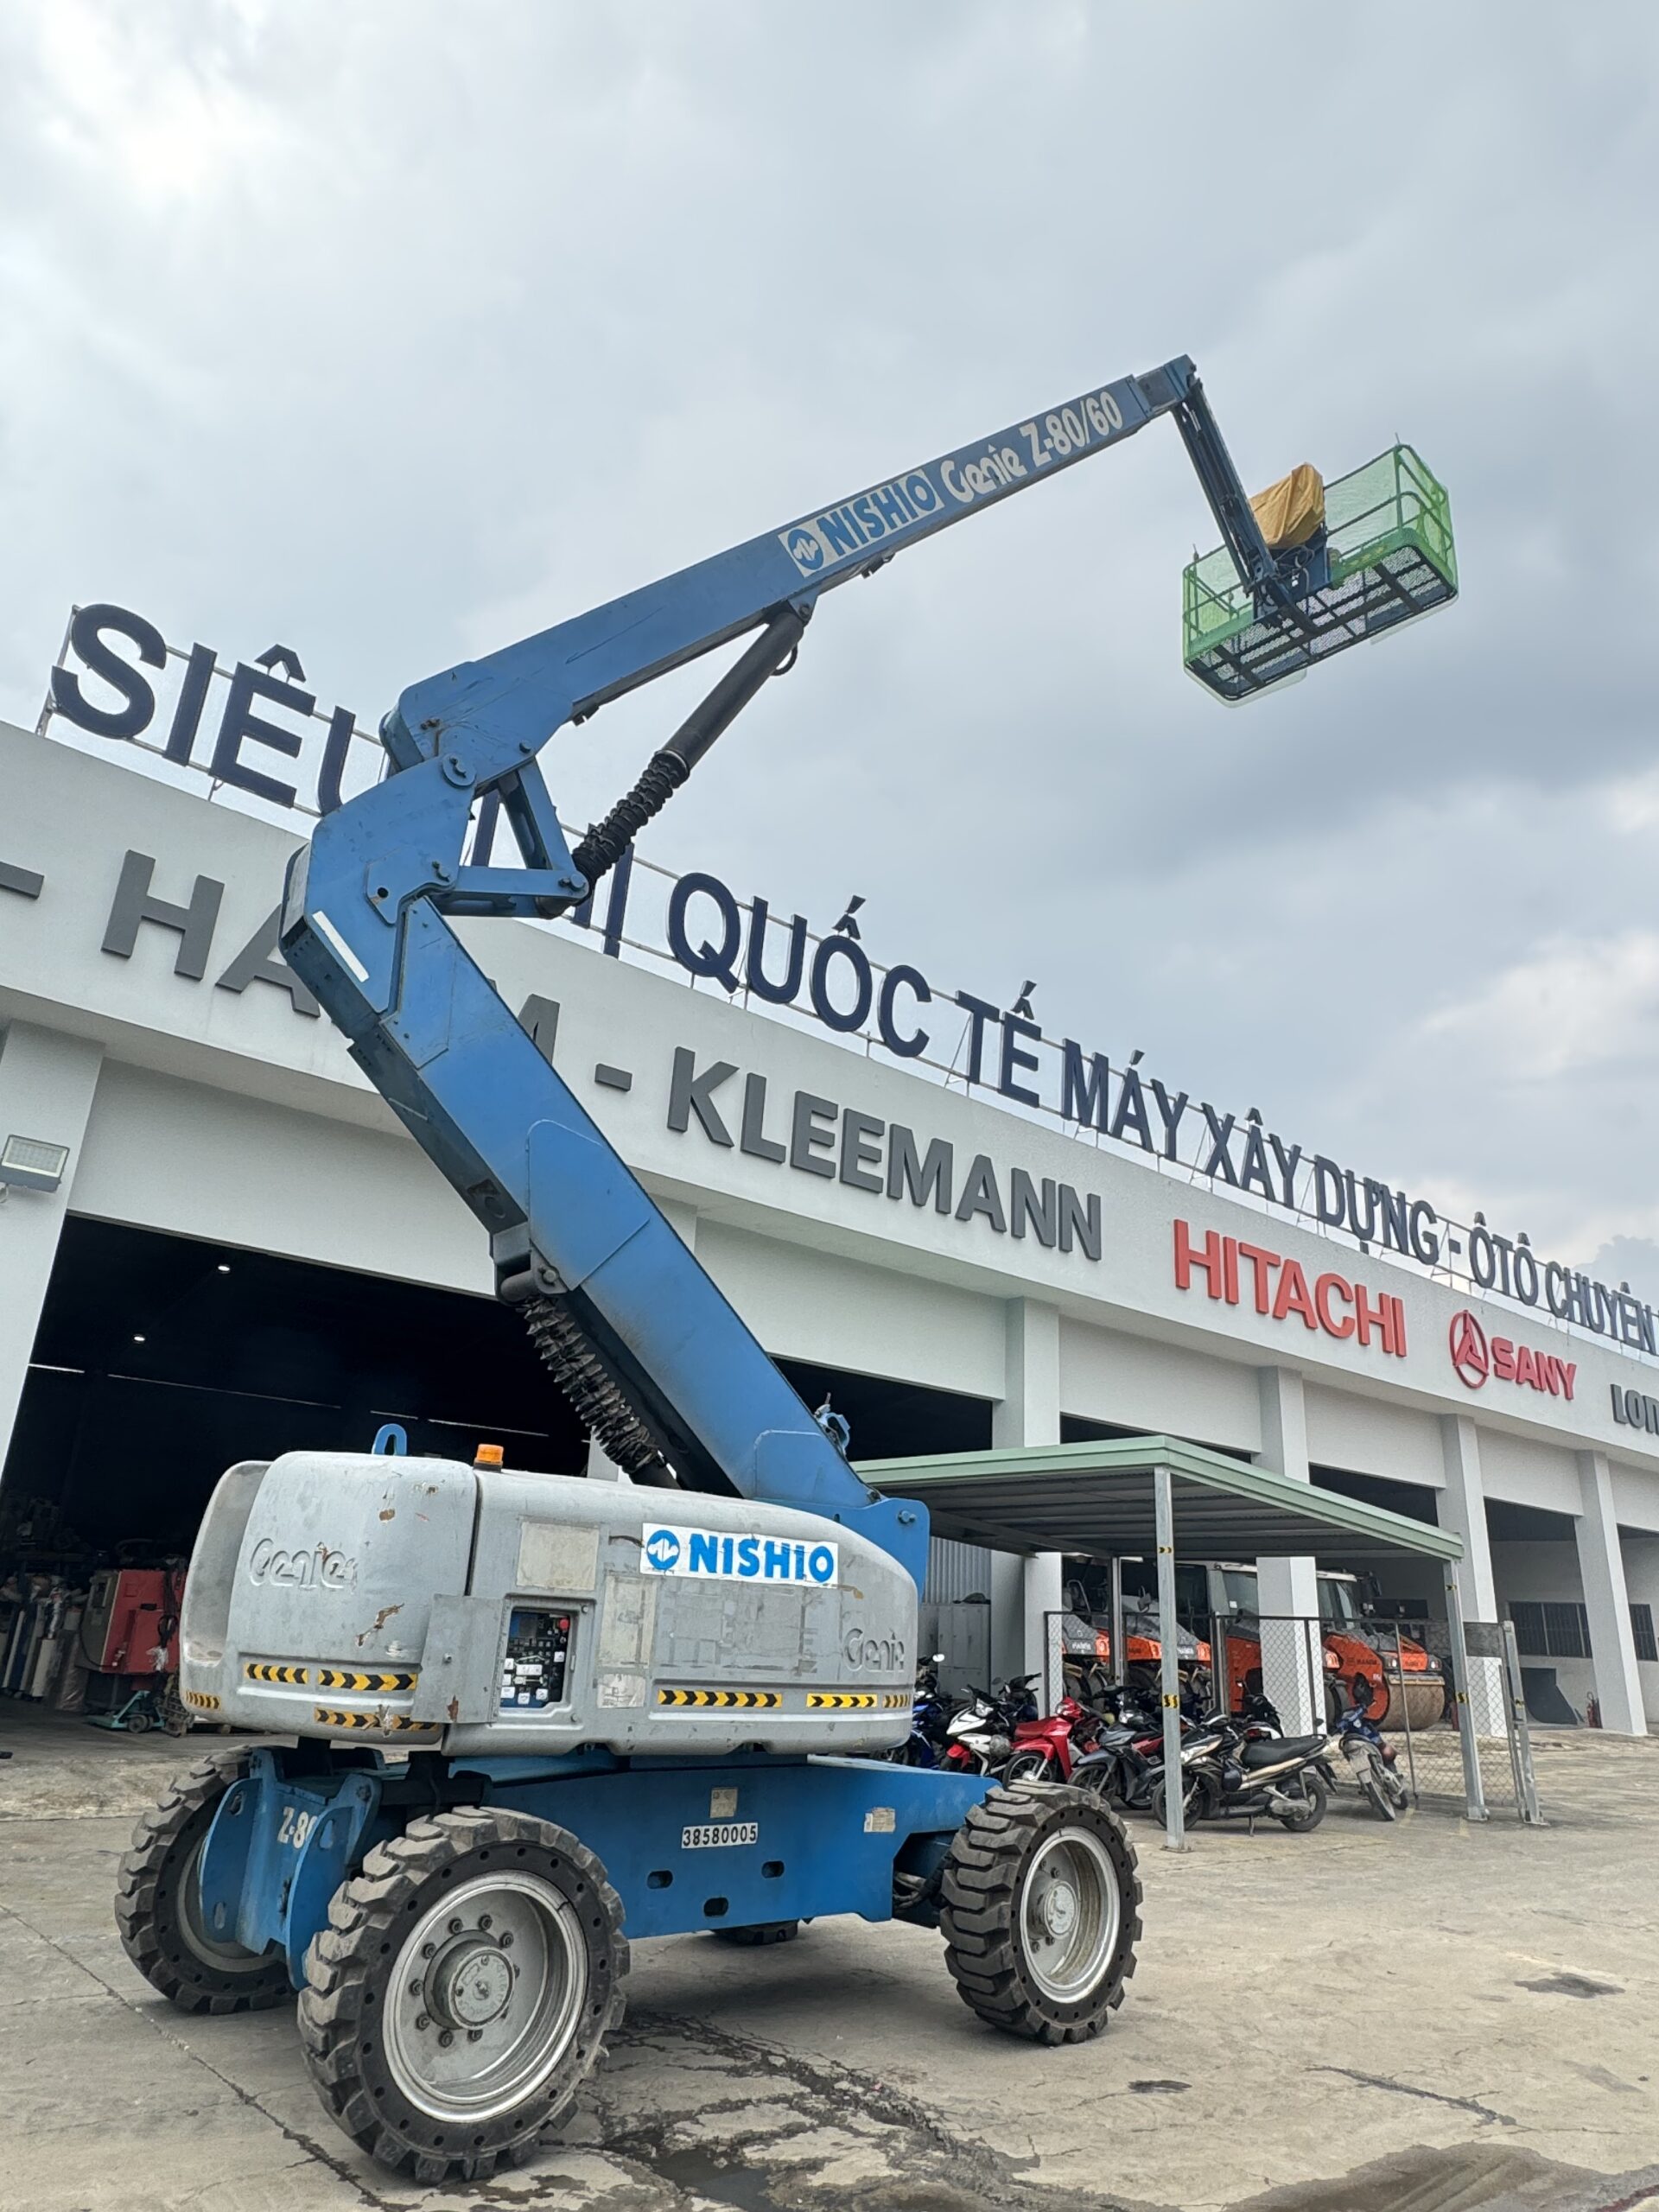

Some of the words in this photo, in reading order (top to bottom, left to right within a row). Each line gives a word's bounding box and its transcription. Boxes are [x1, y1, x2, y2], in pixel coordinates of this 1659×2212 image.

[940, 443, 1027, 503] Genie
[1020, 391, 1123, 467] Z-80/60
[818, 474, 937, 556] NISHIO
[667, 872, 931, 1058] QUỐC
[955, 981, 1042, 1108] TẾ
[1061, 1038, 1189, 1162] MÁY
[1201, 1107, 1302, 1210] XÂY
[1314, 1154, 1440, 1265] DỰNG
[1469, 1211, 1538, 1306] ÔTÔ
[1545, 1261, 1656, 1356] CHUYÊN
[667, 1046, 1102, 1262] KLEEMANN
[1173, 1219, 1407, 1357] HITACHI
[1491, 1337, 1577, 1401] SANY
[689, 1534, 835, 1583] NISHIO
[683, 1824, 757, 1847] 38580005
